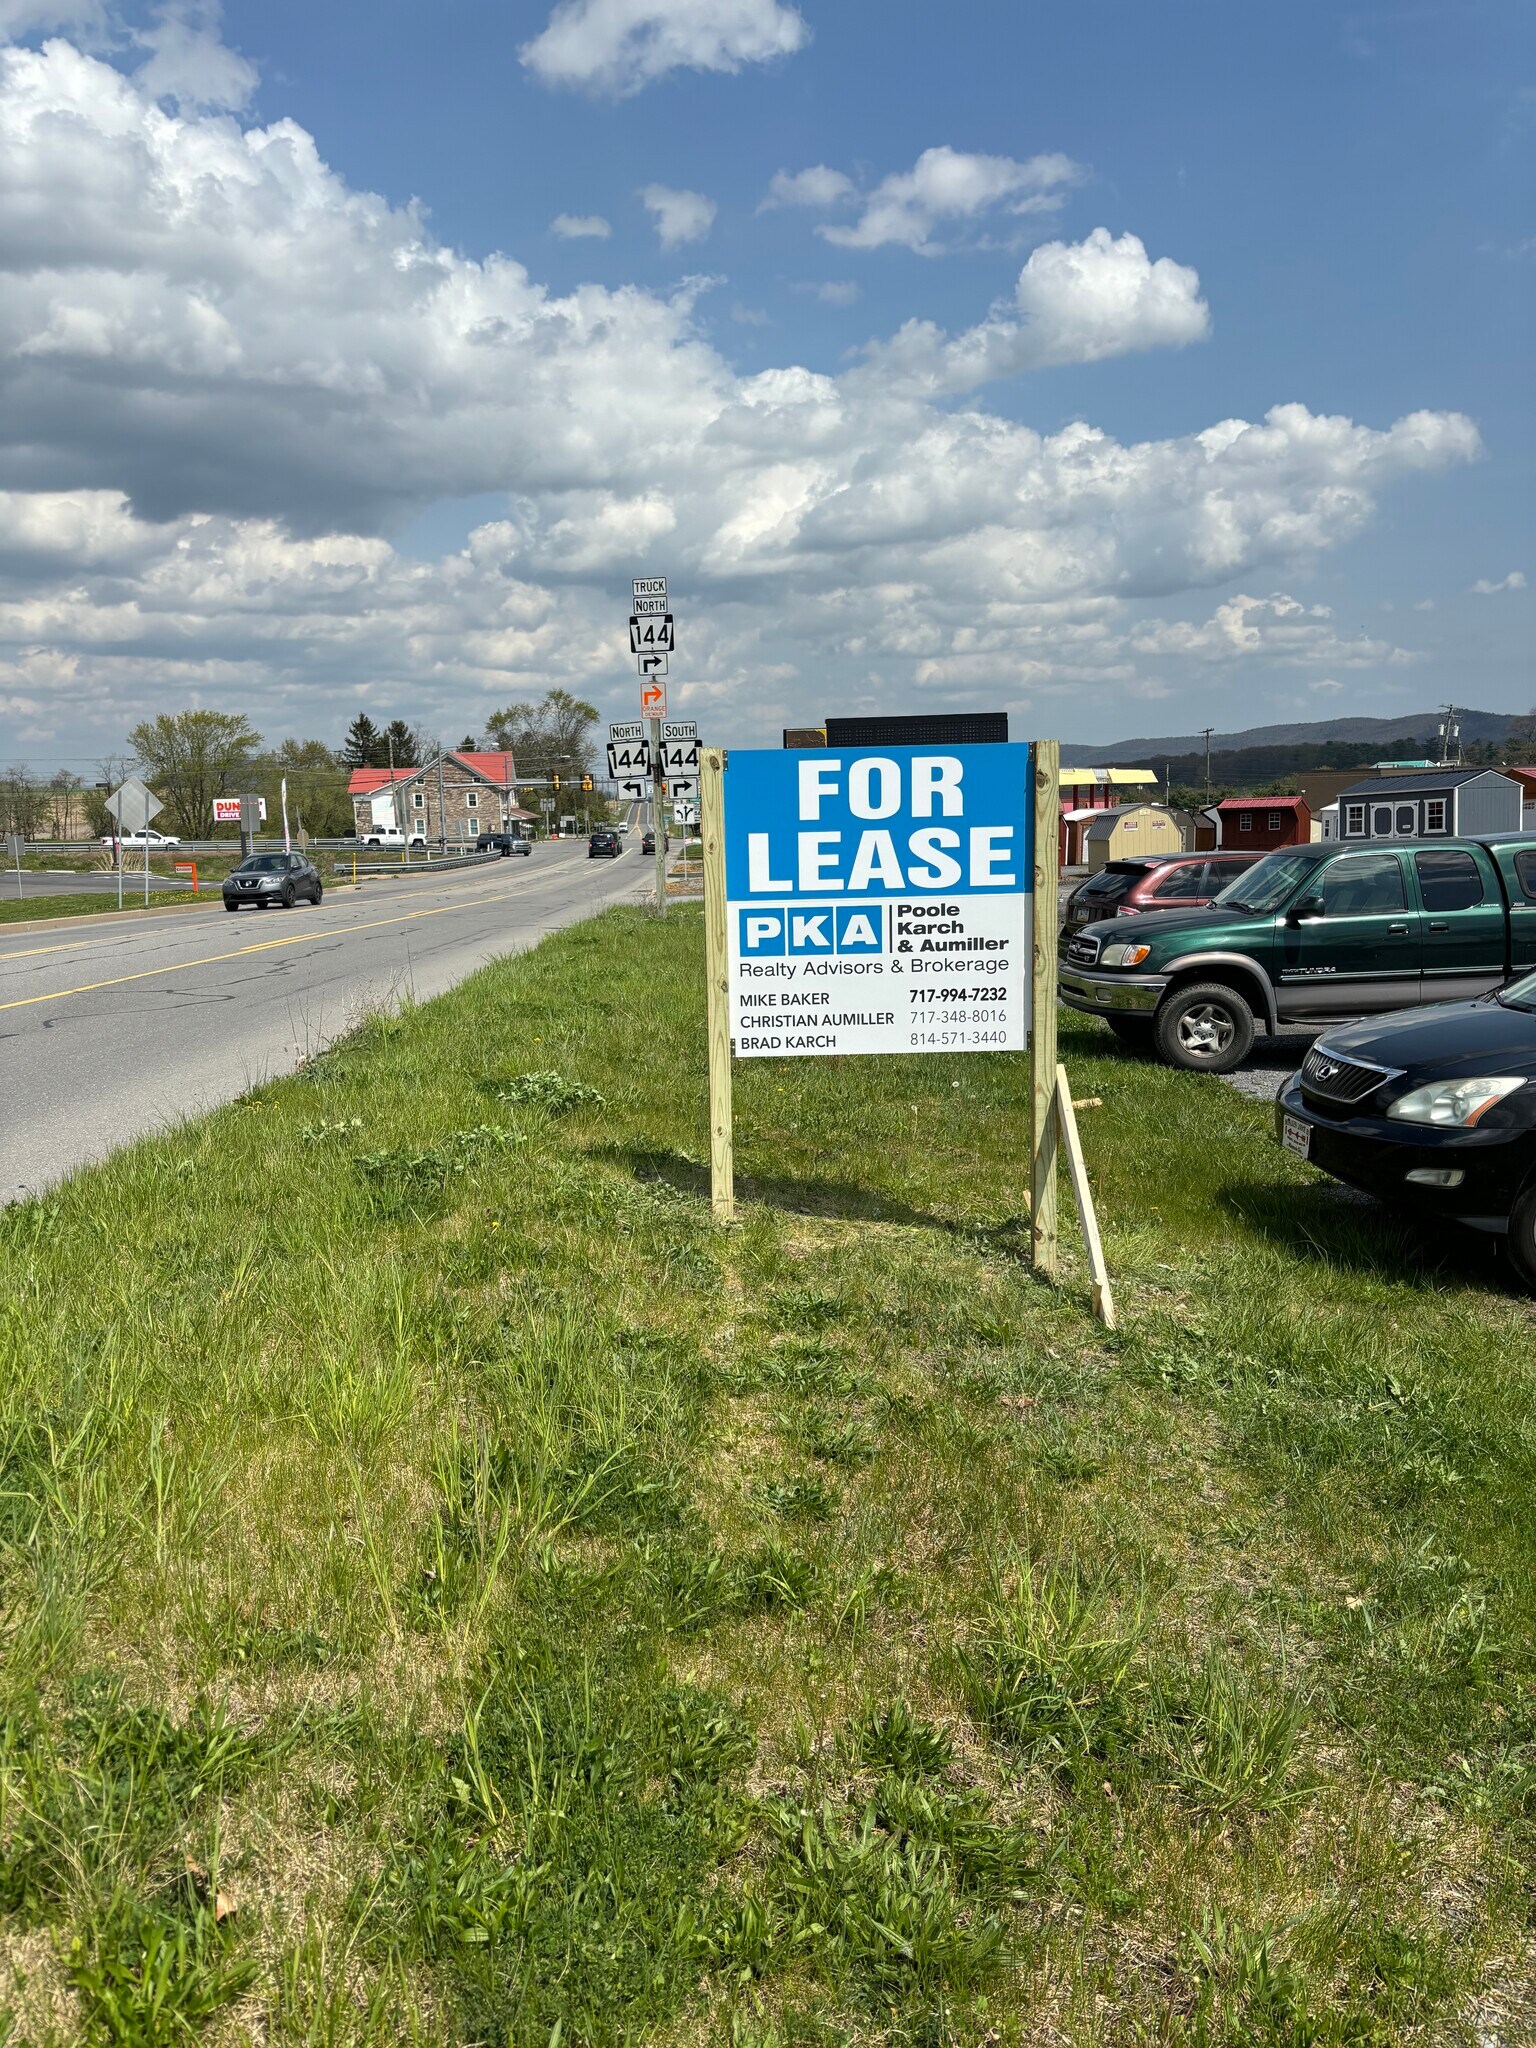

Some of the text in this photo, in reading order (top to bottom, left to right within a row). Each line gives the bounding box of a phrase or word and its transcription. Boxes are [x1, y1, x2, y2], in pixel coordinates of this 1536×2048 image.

[634, 580, 664, 593] TRUCK
[636, 599, 665, 612] NORTH
[635, 624, 669, 645] 144
[612, 725, 641, 739] NORTH
[665, 724, 695, 737] SOUTH
[612, 749, 647, 769] 144
[663, 748, 699, 768] 144
[798, 756, 964, 821] FOR
[748, 826, 1016, 892] LEASE
[897, 903, 960, 918] Poole
[746, 914, 878, 948] PKA
[897, 921, 964, 935] Karch
[897, 937, 1009, 952] & Aumiller
[739, 958, 1009, 979] Realty Advisors & Brokerage
[740, 988, 1007, 1007] MIKE BAKER 717-994-7232
[740, 1010, 1006, 1028] CHRISTIAN AUMILLER 717-348-8016
[741, 1031, 1006, 1049] BRAD KARCH 814-571-3440
